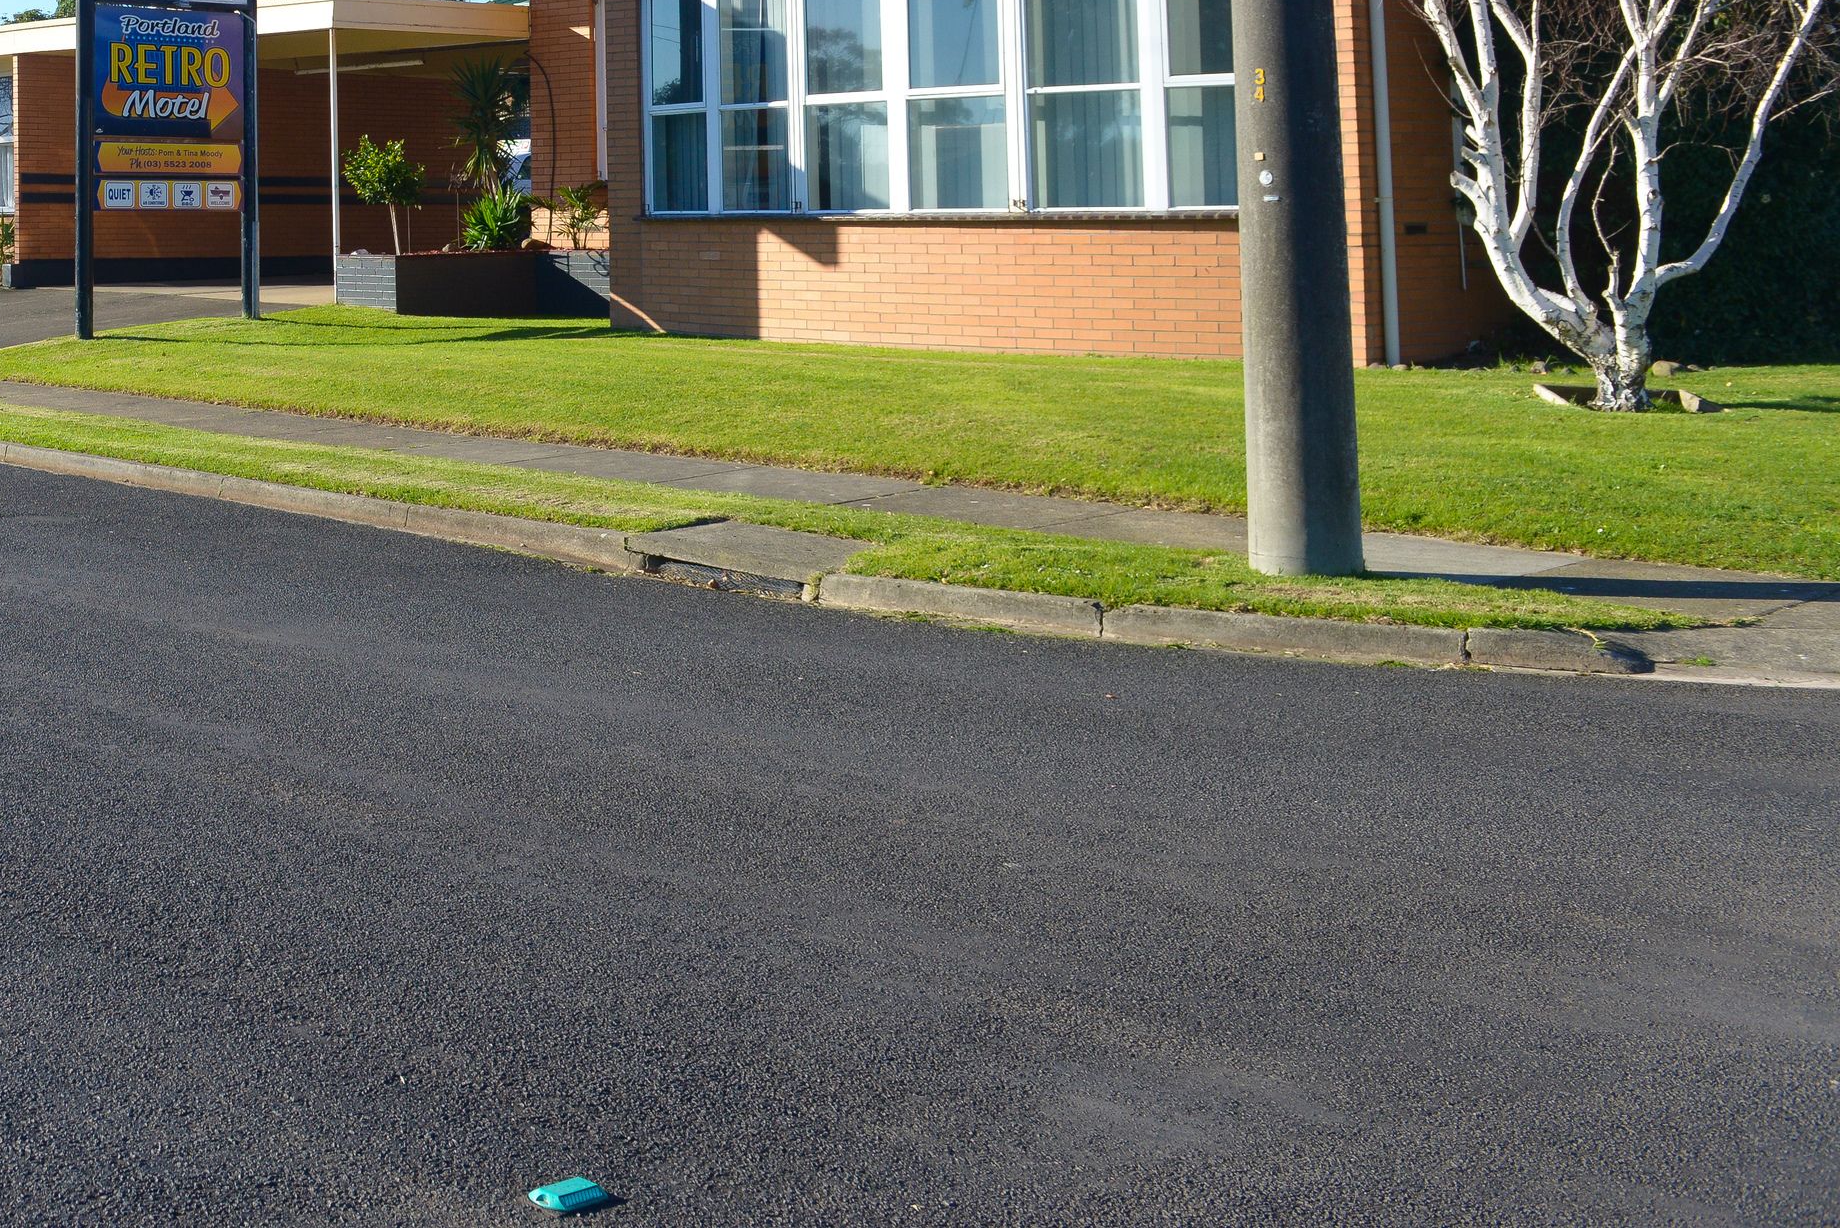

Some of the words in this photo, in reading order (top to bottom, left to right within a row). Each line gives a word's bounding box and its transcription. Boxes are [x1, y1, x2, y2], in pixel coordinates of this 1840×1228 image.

[120, 15, 220, 37] Portland
[110, 42, 230, 88] RETRO
[122, 89, 210, 120] Motel
[117, 145, 133, 157] Your
[176, 149, 182, 157] &
[184, 149, 199, 157] Tina
[199, 150, 223, 159] Moody
[143, 160, 162, 170] (03)
[164, 160, 187, 169] 5523
[189, 161, 212, 169] 2008
[108, 188, 131, 201] QUIET
